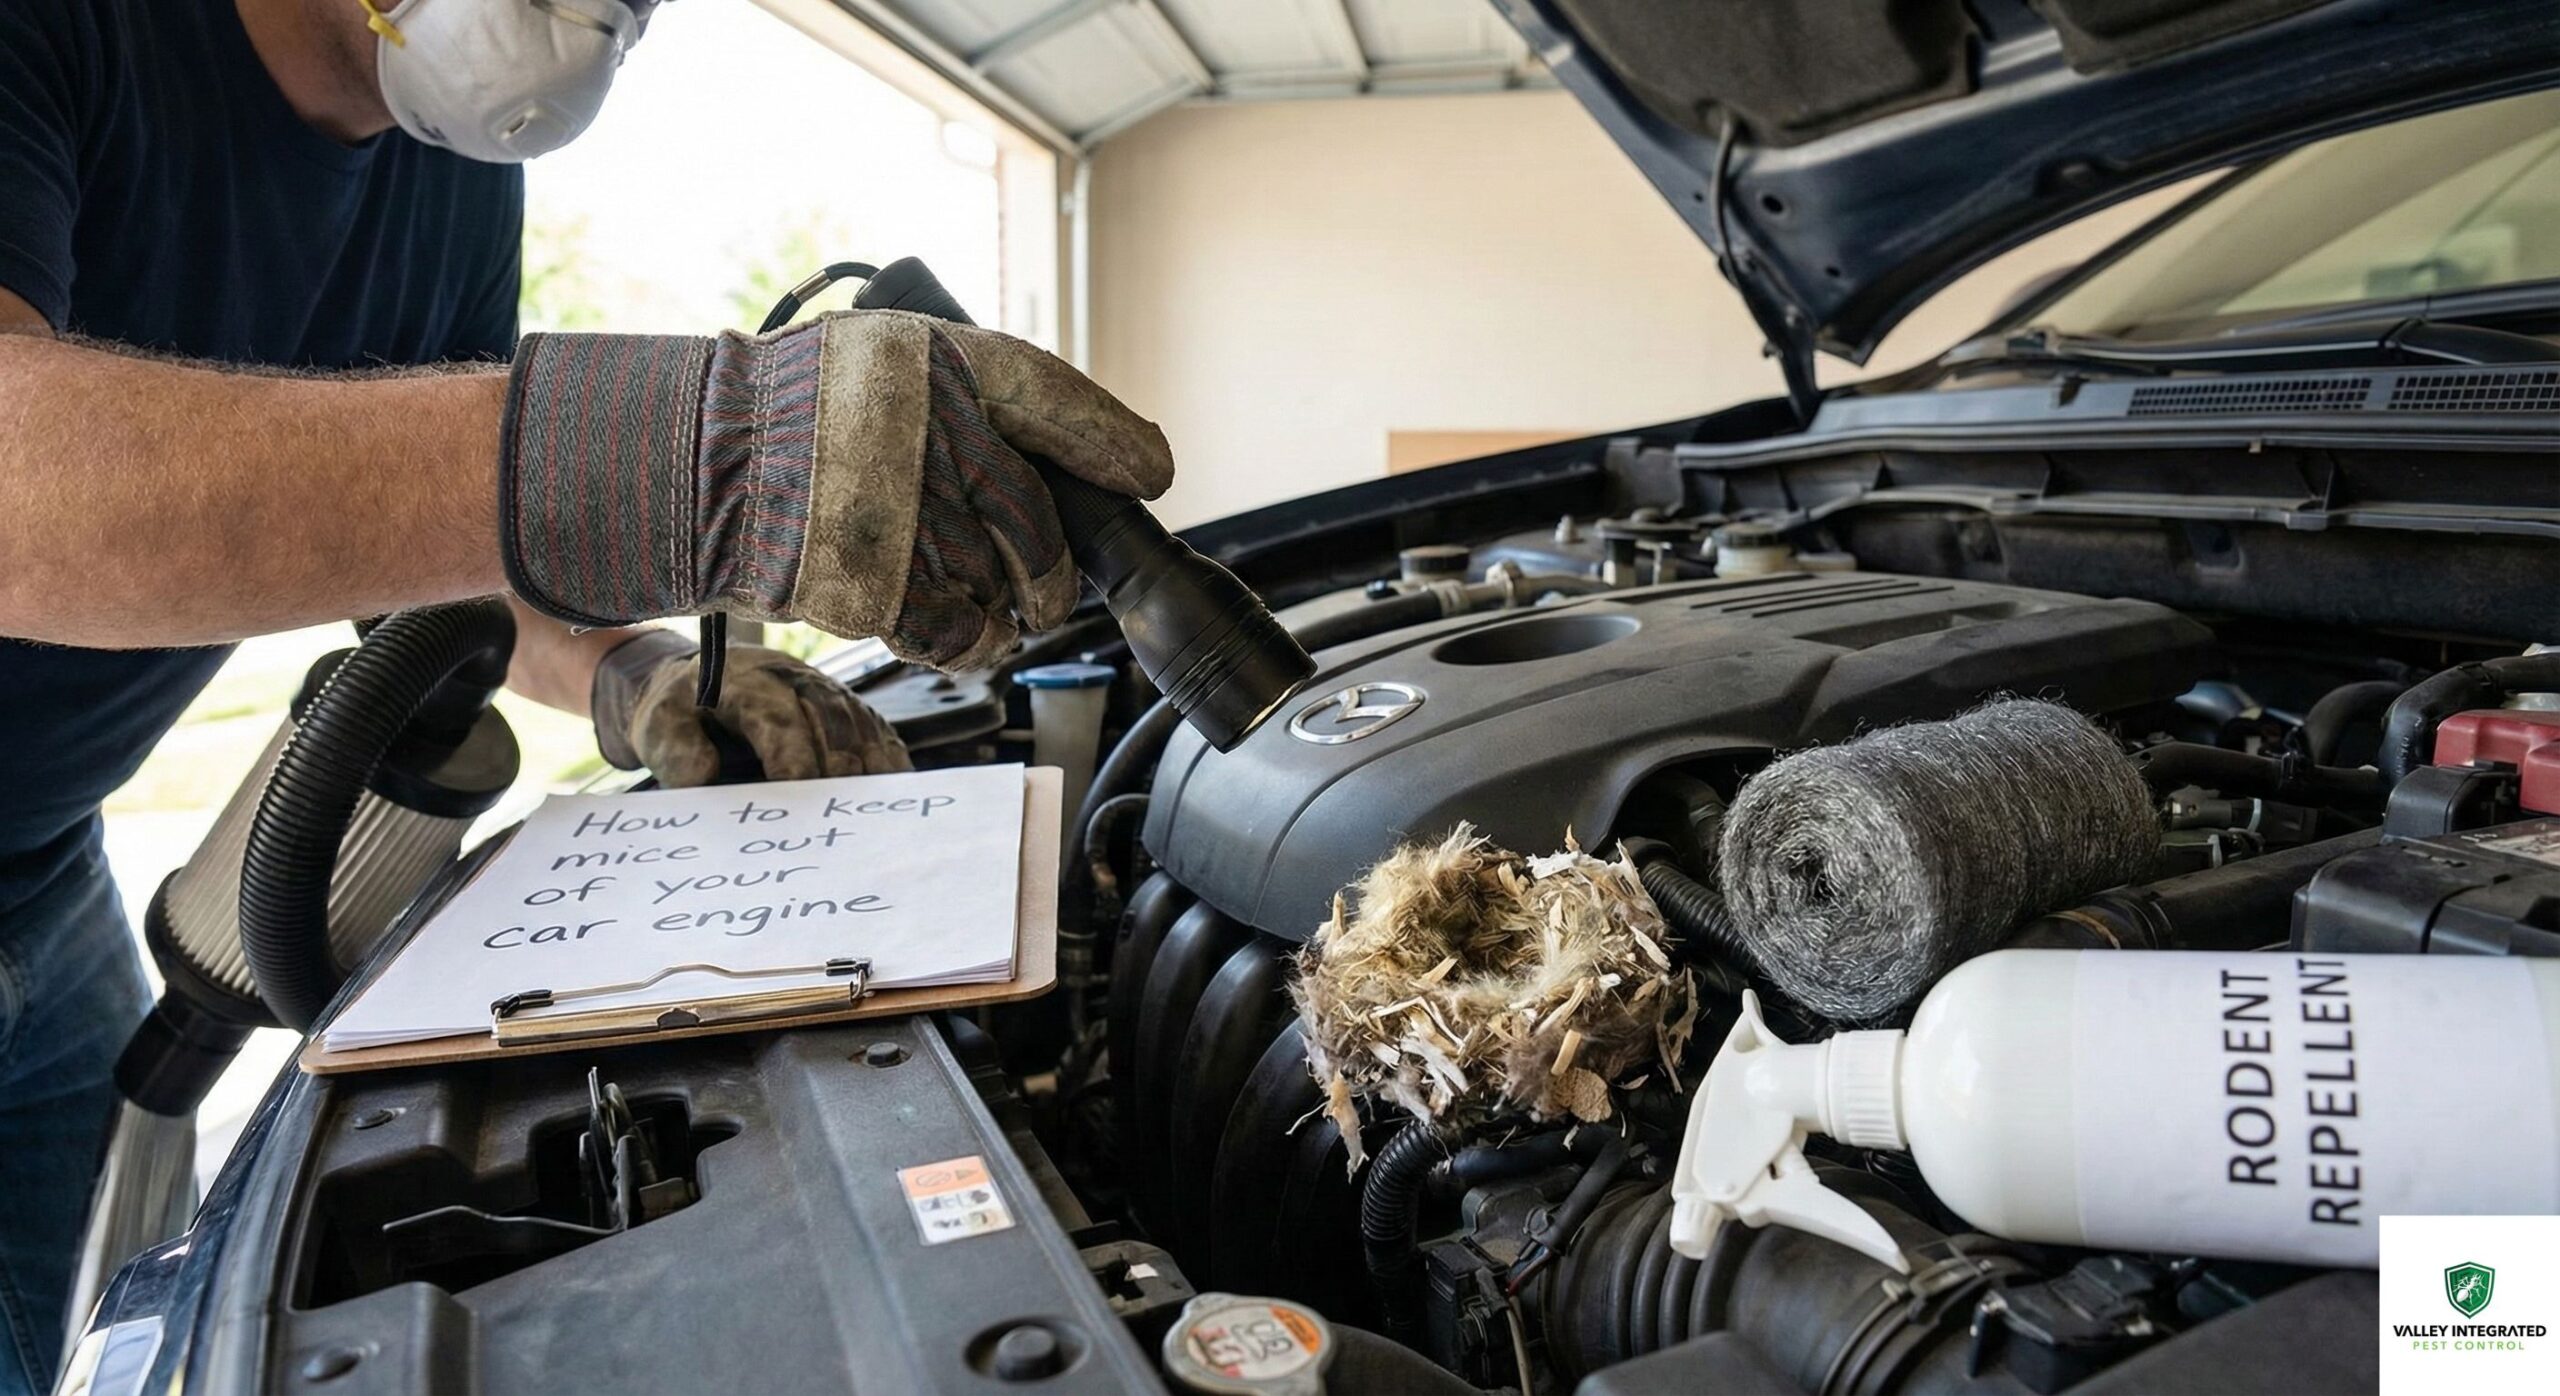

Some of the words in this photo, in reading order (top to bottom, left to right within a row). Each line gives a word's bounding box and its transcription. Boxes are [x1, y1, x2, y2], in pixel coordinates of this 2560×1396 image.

[572, 809, 700, 839] How
[730, 801, 790, 824] to
[550, 846, 700, 872] mice
[740, 827, 856, 854] out
[523, 876, 617, 906] of
[652, 865, 819, 905] your
[482, 919, 618, 949] car
[652, 895, 894, 937] engine
[2220, 969, 2278, 1186] RODENT
[2296, 957, 2362, 1227] REPELLENT
